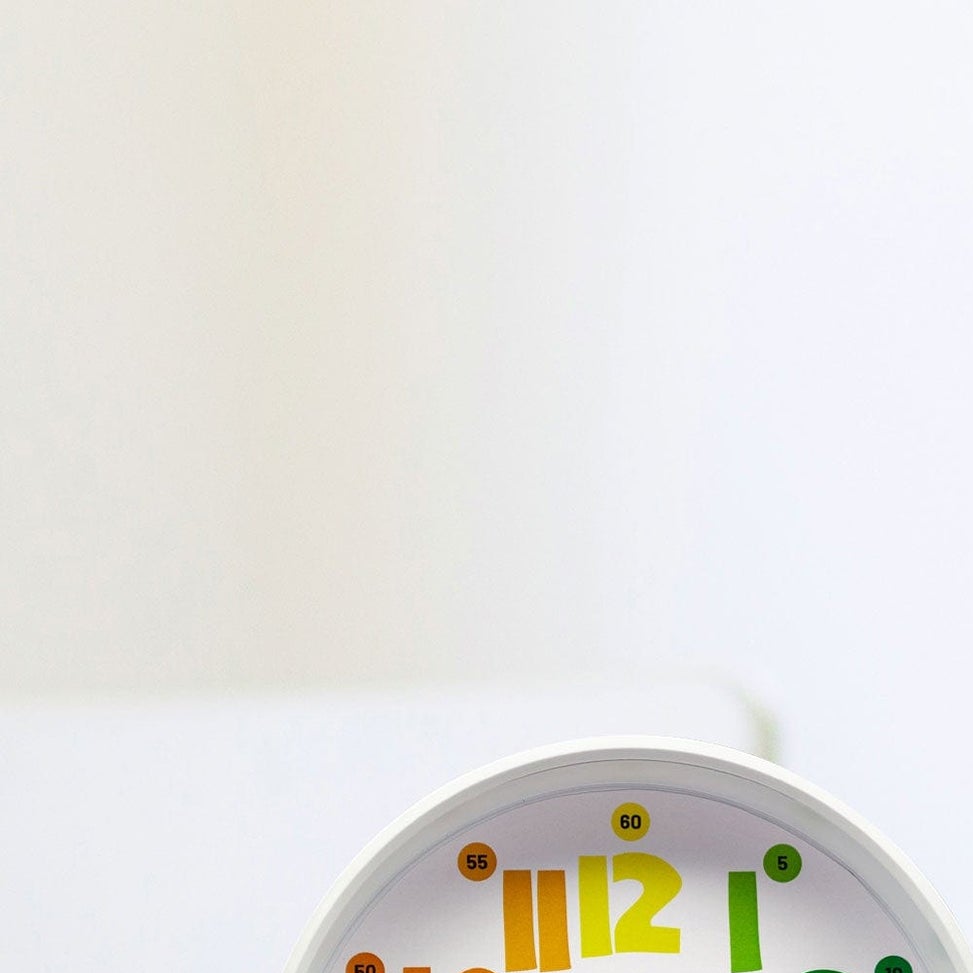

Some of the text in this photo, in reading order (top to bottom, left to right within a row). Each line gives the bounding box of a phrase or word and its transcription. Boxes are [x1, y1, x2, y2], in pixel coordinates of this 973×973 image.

[620, 815, 641, 829] 60
[467, 855, 487, 869] 55
[777, 855, 788, 870] 5
[578, 852, 682, 958] 12
